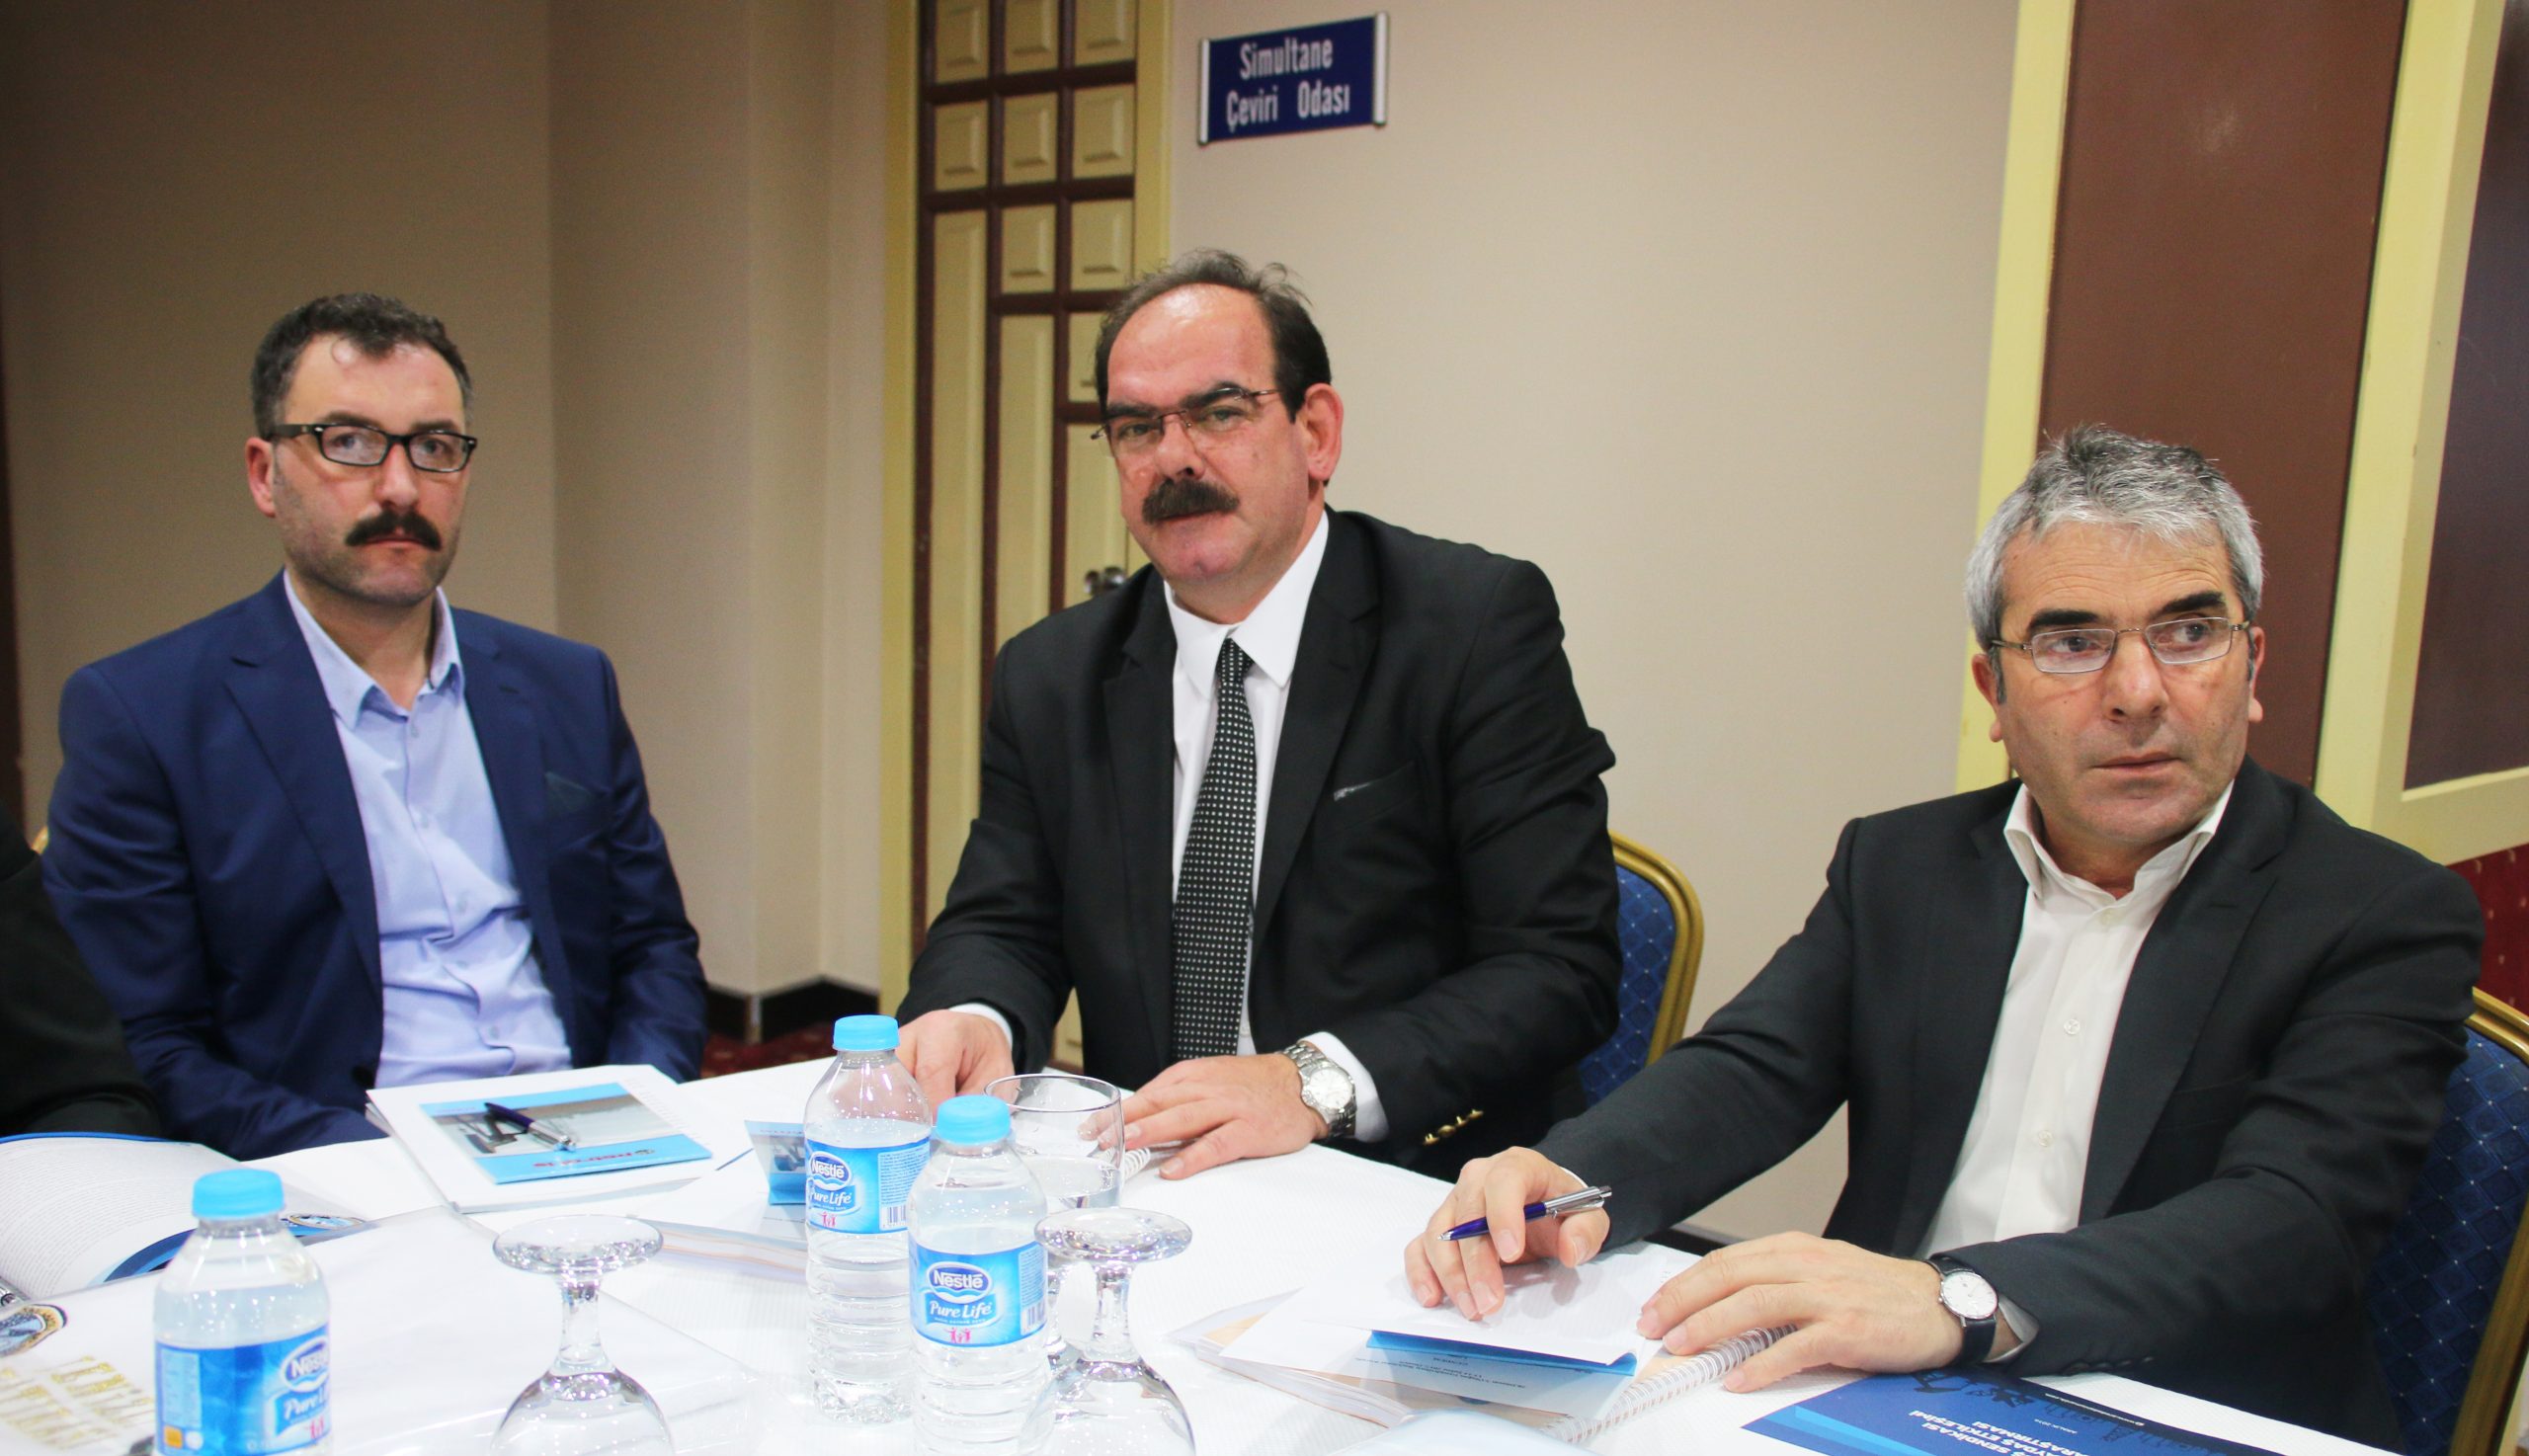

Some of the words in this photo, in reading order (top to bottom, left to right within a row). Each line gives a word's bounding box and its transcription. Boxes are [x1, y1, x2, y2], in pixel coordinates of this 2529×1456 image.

[1240, 37, 1333, 80] Simultane
[1226, 85, 1278, 133] Çeviri
[1297, 79, 1350, 119] Odası
[930, 1300, 961, 1318] Pure
[962, 1302, 992, 1319] Life
